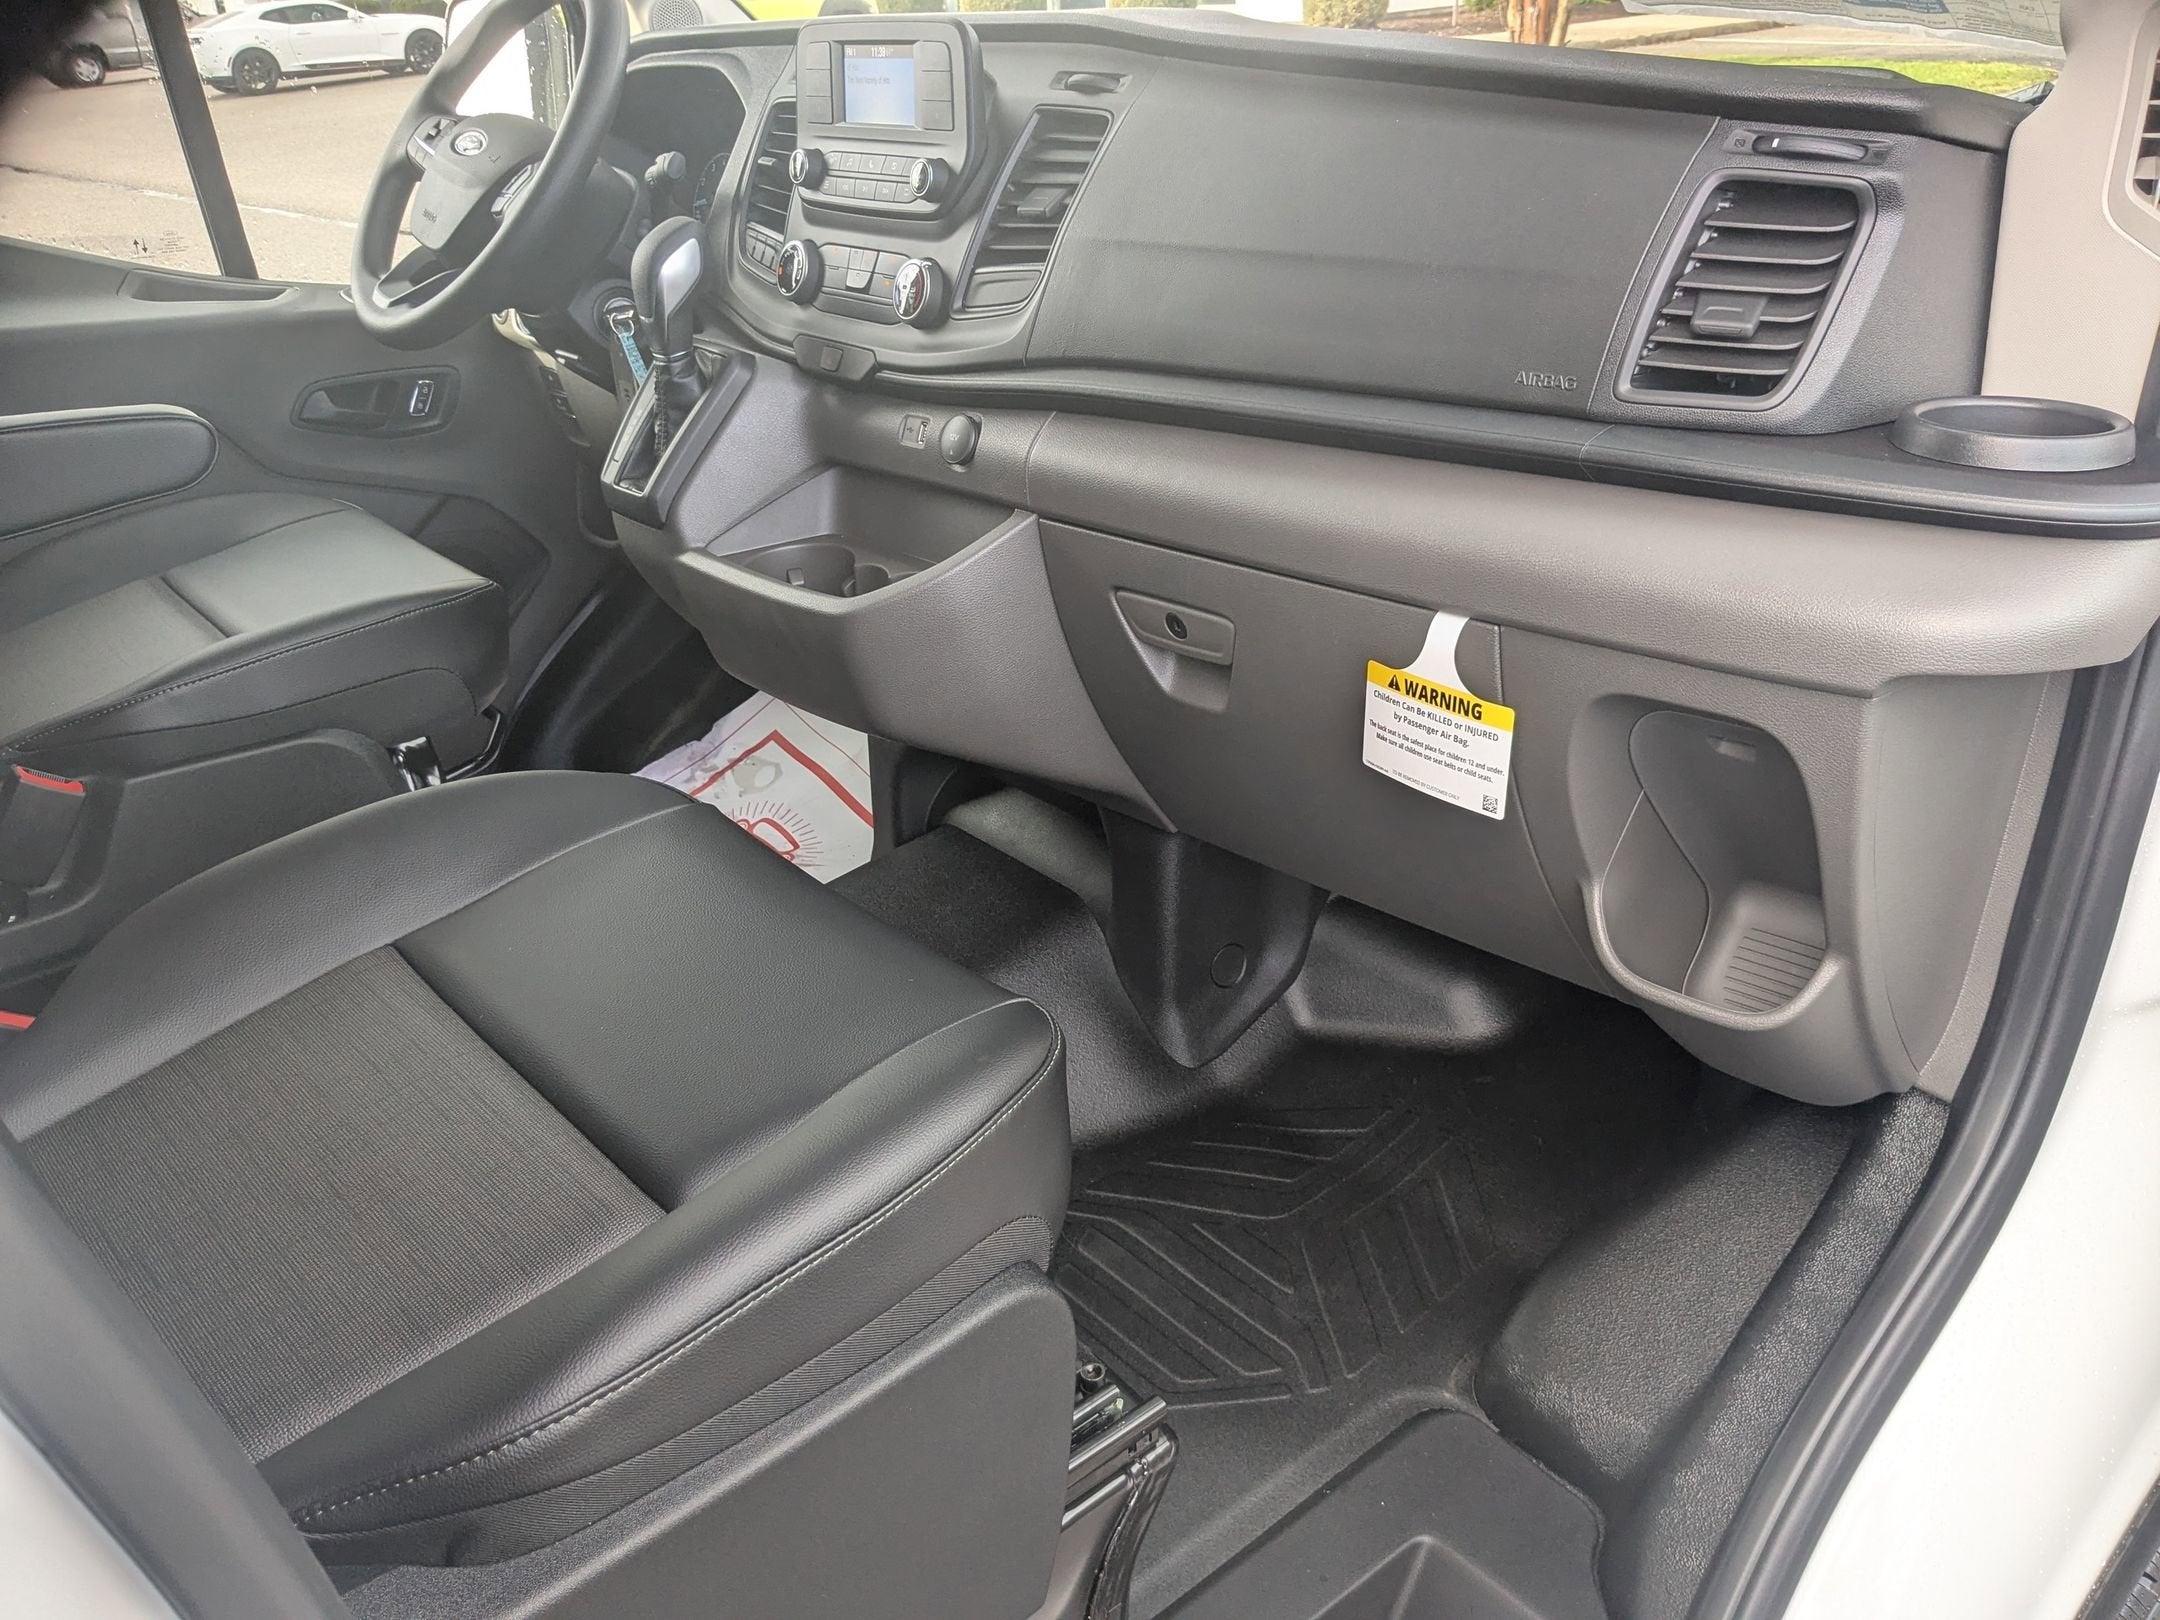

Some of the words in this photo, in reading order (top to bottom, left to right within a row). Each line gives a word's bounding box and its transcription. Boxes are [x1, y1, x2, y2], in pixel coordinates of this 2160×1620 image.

[1514, 371, 1577, 391] AIRBAG
[1373, 690, 1400, 707] Children
[1402, 702, 1415, 713] Can
[1416, 707, 1426, 717] Be
[1427, 711, 1452, 726] KILLED
[1454, 722, 1463, 730] or
[1464, 724, 1499, 741] INJURED
[1404, 678, 1482, 720] WARNING
[1369, 719, 1377, 728] The
[1377, 722, 1387, 733] back
[1388, 728, 1397, 736] seat
[1402, 734, 1410, 742] the
[1410, 738, 1424, 748] safest
[1424, 743, 1437, 754] place
[1437, 747, 1446, 756] for
[1446, 751, 1467, 764] children
[1468, 759, 1475, 767] 12
[1475, 762, 1486, 770] and
[1393, 711, 1402, 723] by
[1403, 716, 1439, 735] Passenger
[1440, 730, 1452, 740] Air
[1376, 732, 1388, 742] Make
[1388, 739, 1397, 747] sure
[1404, 745, 1423, 758] children
[1423, 753, 1432, 762] use
[1432, 757, 1443, 766] seat
[1444, 760, 1456, 771] belts
[1463, 768, 1477, 778] child
